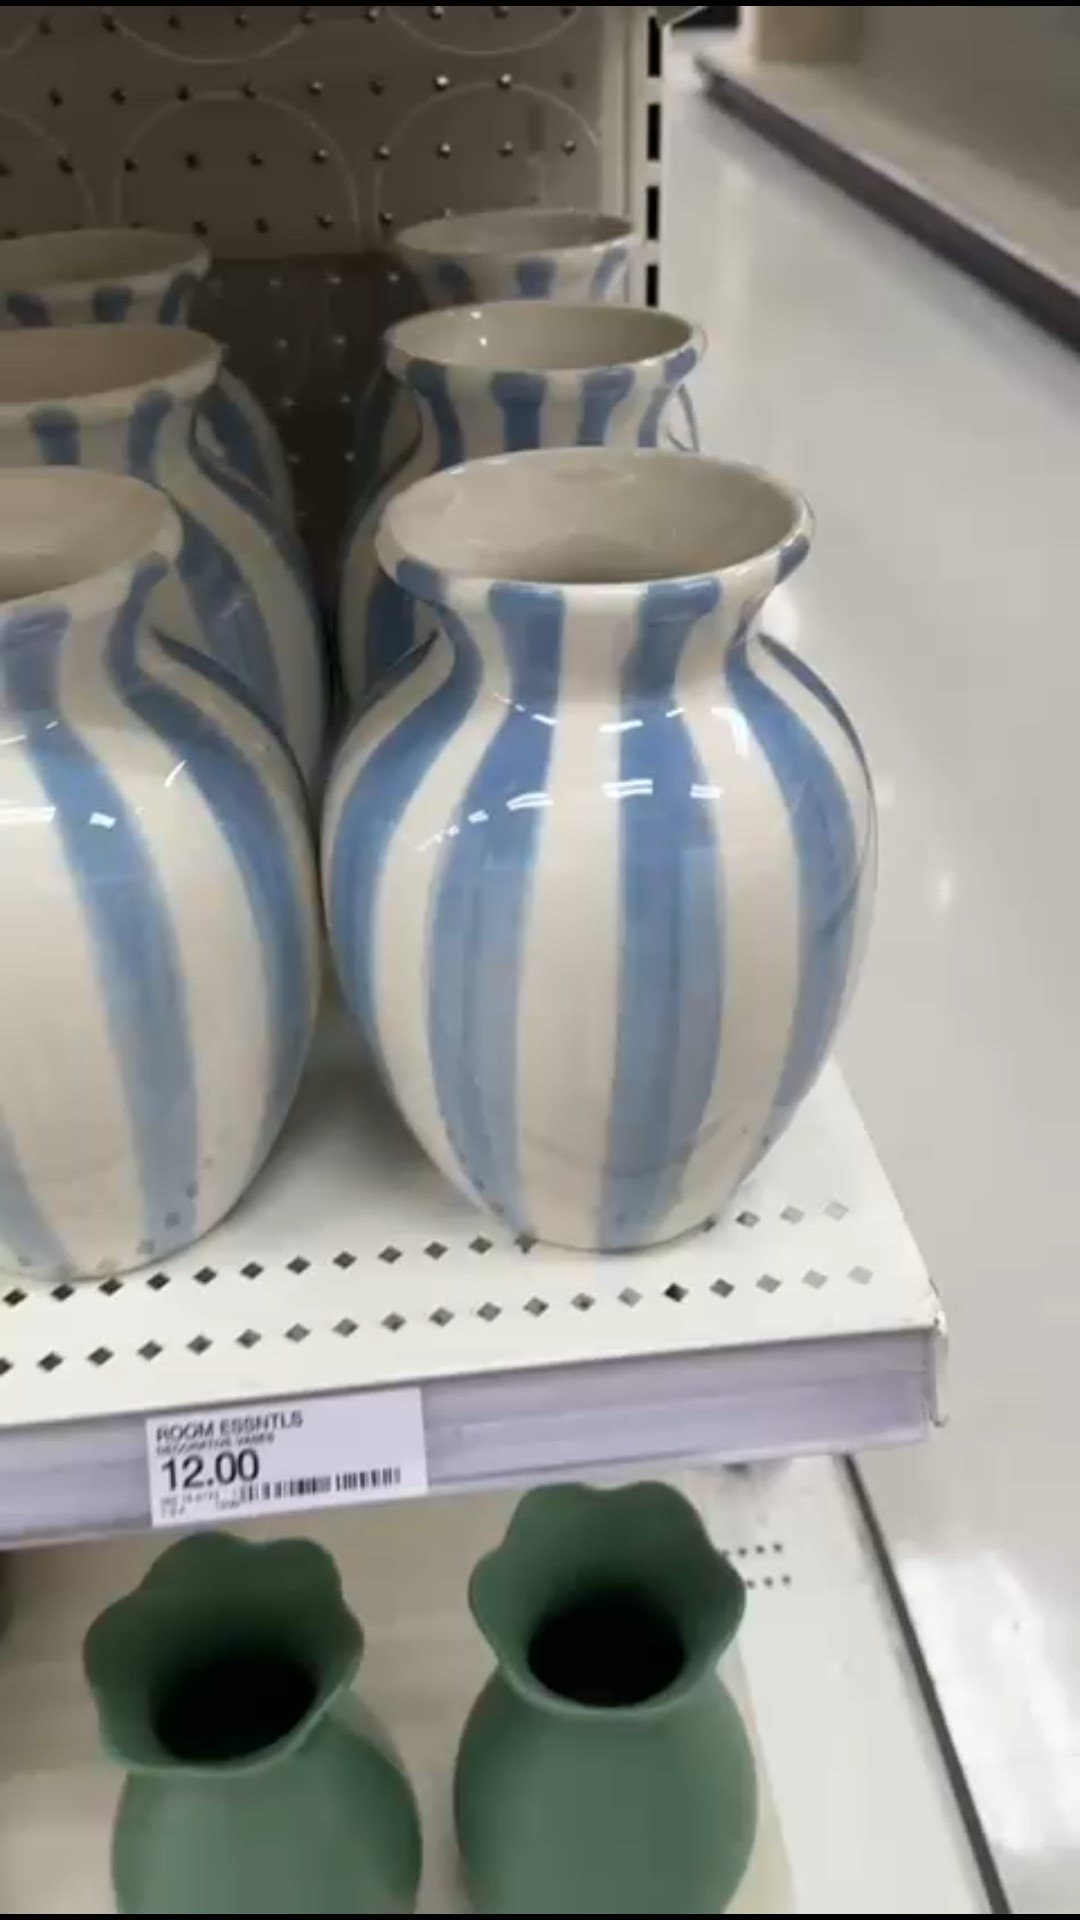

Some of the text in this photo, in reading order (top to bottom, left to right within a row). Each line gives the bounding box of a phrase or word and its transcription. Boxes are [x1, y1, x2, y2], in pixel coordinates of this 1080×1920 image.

[156, 1410, 303, 1442] ROOM ESSNTLS
[161, 1447, 260, 1491] 12.00
